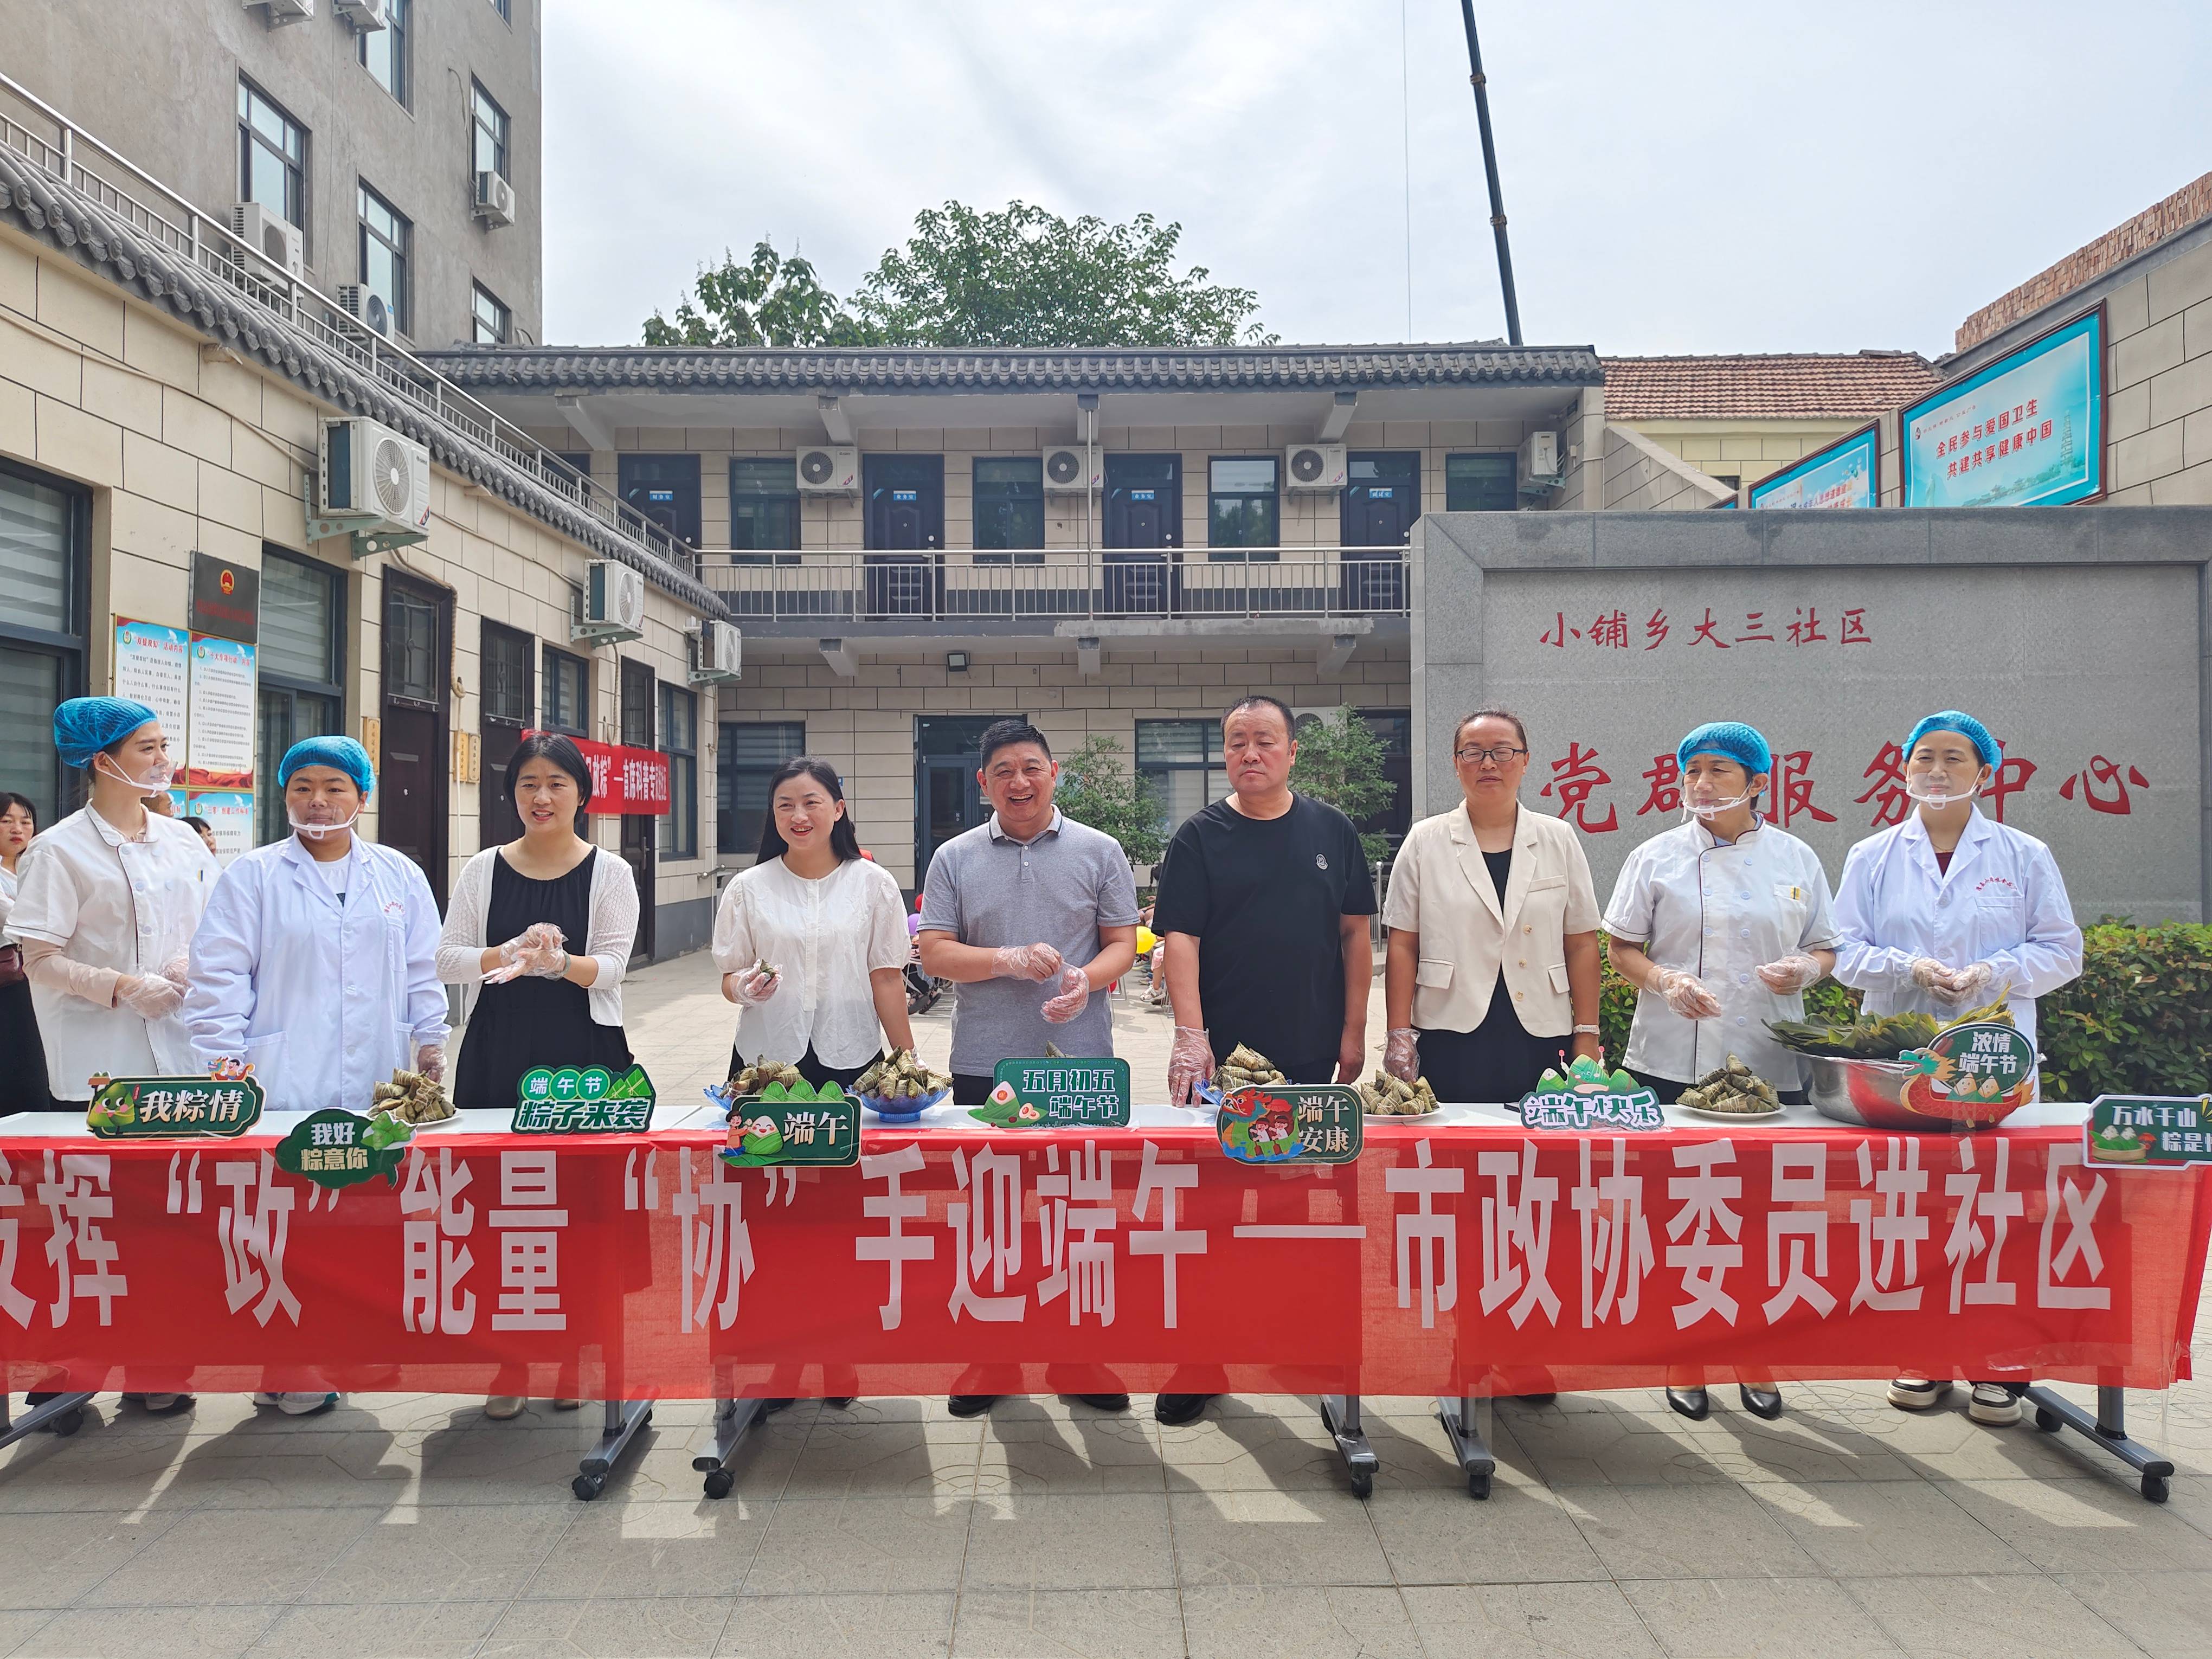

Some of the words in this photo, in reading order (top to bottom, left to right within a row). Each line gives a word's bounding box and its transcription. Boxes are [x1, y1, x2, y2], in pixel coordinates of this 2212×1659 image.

[1936, 398, 2038, 459] 全民参与爱国卫生
[1947, 419, 2052, 480] 共建共享健康中国
[1539, 607, 1872, 650] 小铺乡大三社区
[1971, 1031, 2012, 1054] 浓情
[1958, 1052, 2017, 1075] 端午节
[529, 1077, 602, 1094] 端午节
[1023, 1069, 1116, 1092] 五月初五
[139, 1088, 245, 1123] 我粽情
[520, 1098, 650, 1130] 粽子来袭
[1049, 1095, 1120, 1120] 端午节
[1297, 1095, 1350, 1124] 端午
[1525, 1091, 1659, 1128] 端午快乐
[2112, 1105, 2197, 1128] 万水千山
[310, 1122, 356, 1146] 我好
[782, 1111, 849, 1146] 端午
[1299, 1126, 1351, 1154] 安康
[300, 1148, 369, 1172] 粽意你
